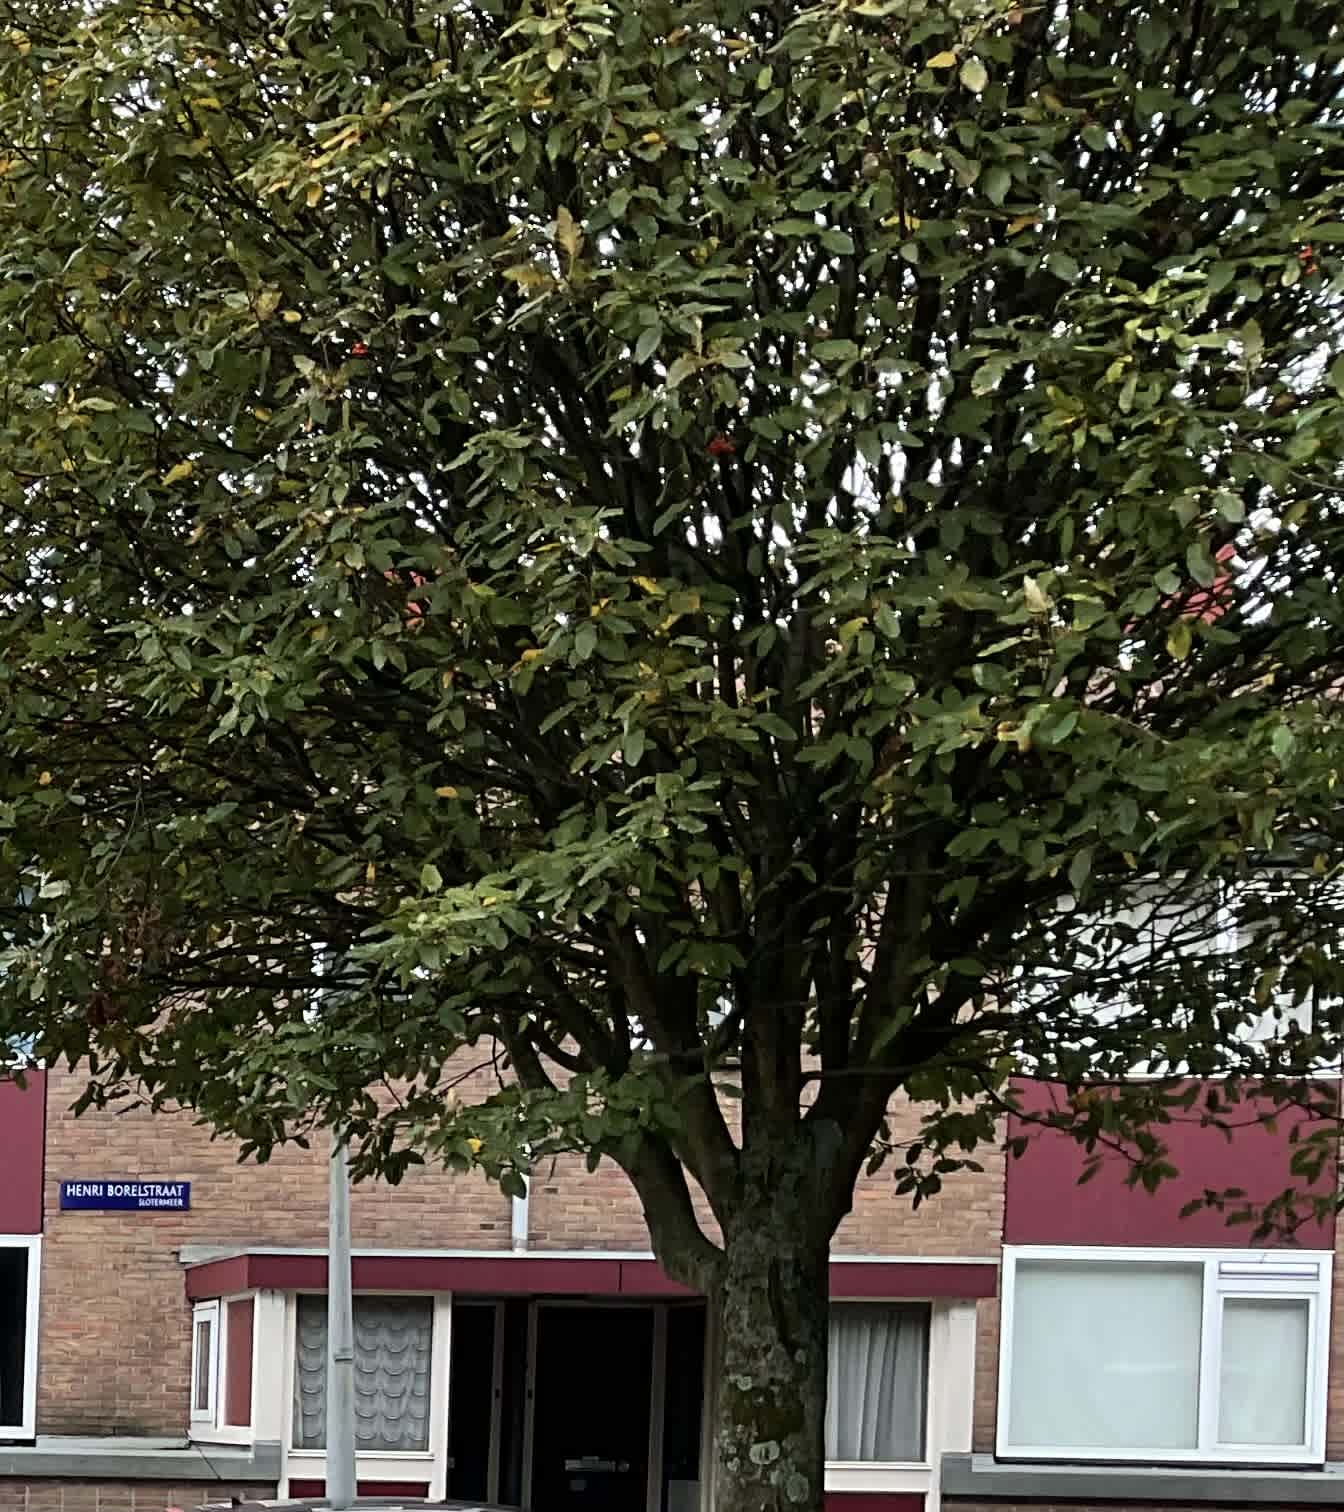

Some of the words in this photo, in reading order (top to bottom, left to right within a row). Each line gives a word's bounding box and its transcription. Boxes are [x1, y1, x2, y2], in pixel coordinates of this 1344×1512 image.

[66, 1184, 103, 1197] HENRI
[107, 1184, 184, 1197] BORELSTRAAT
[138, 1198, 183, 1207] SLOTERMEER
